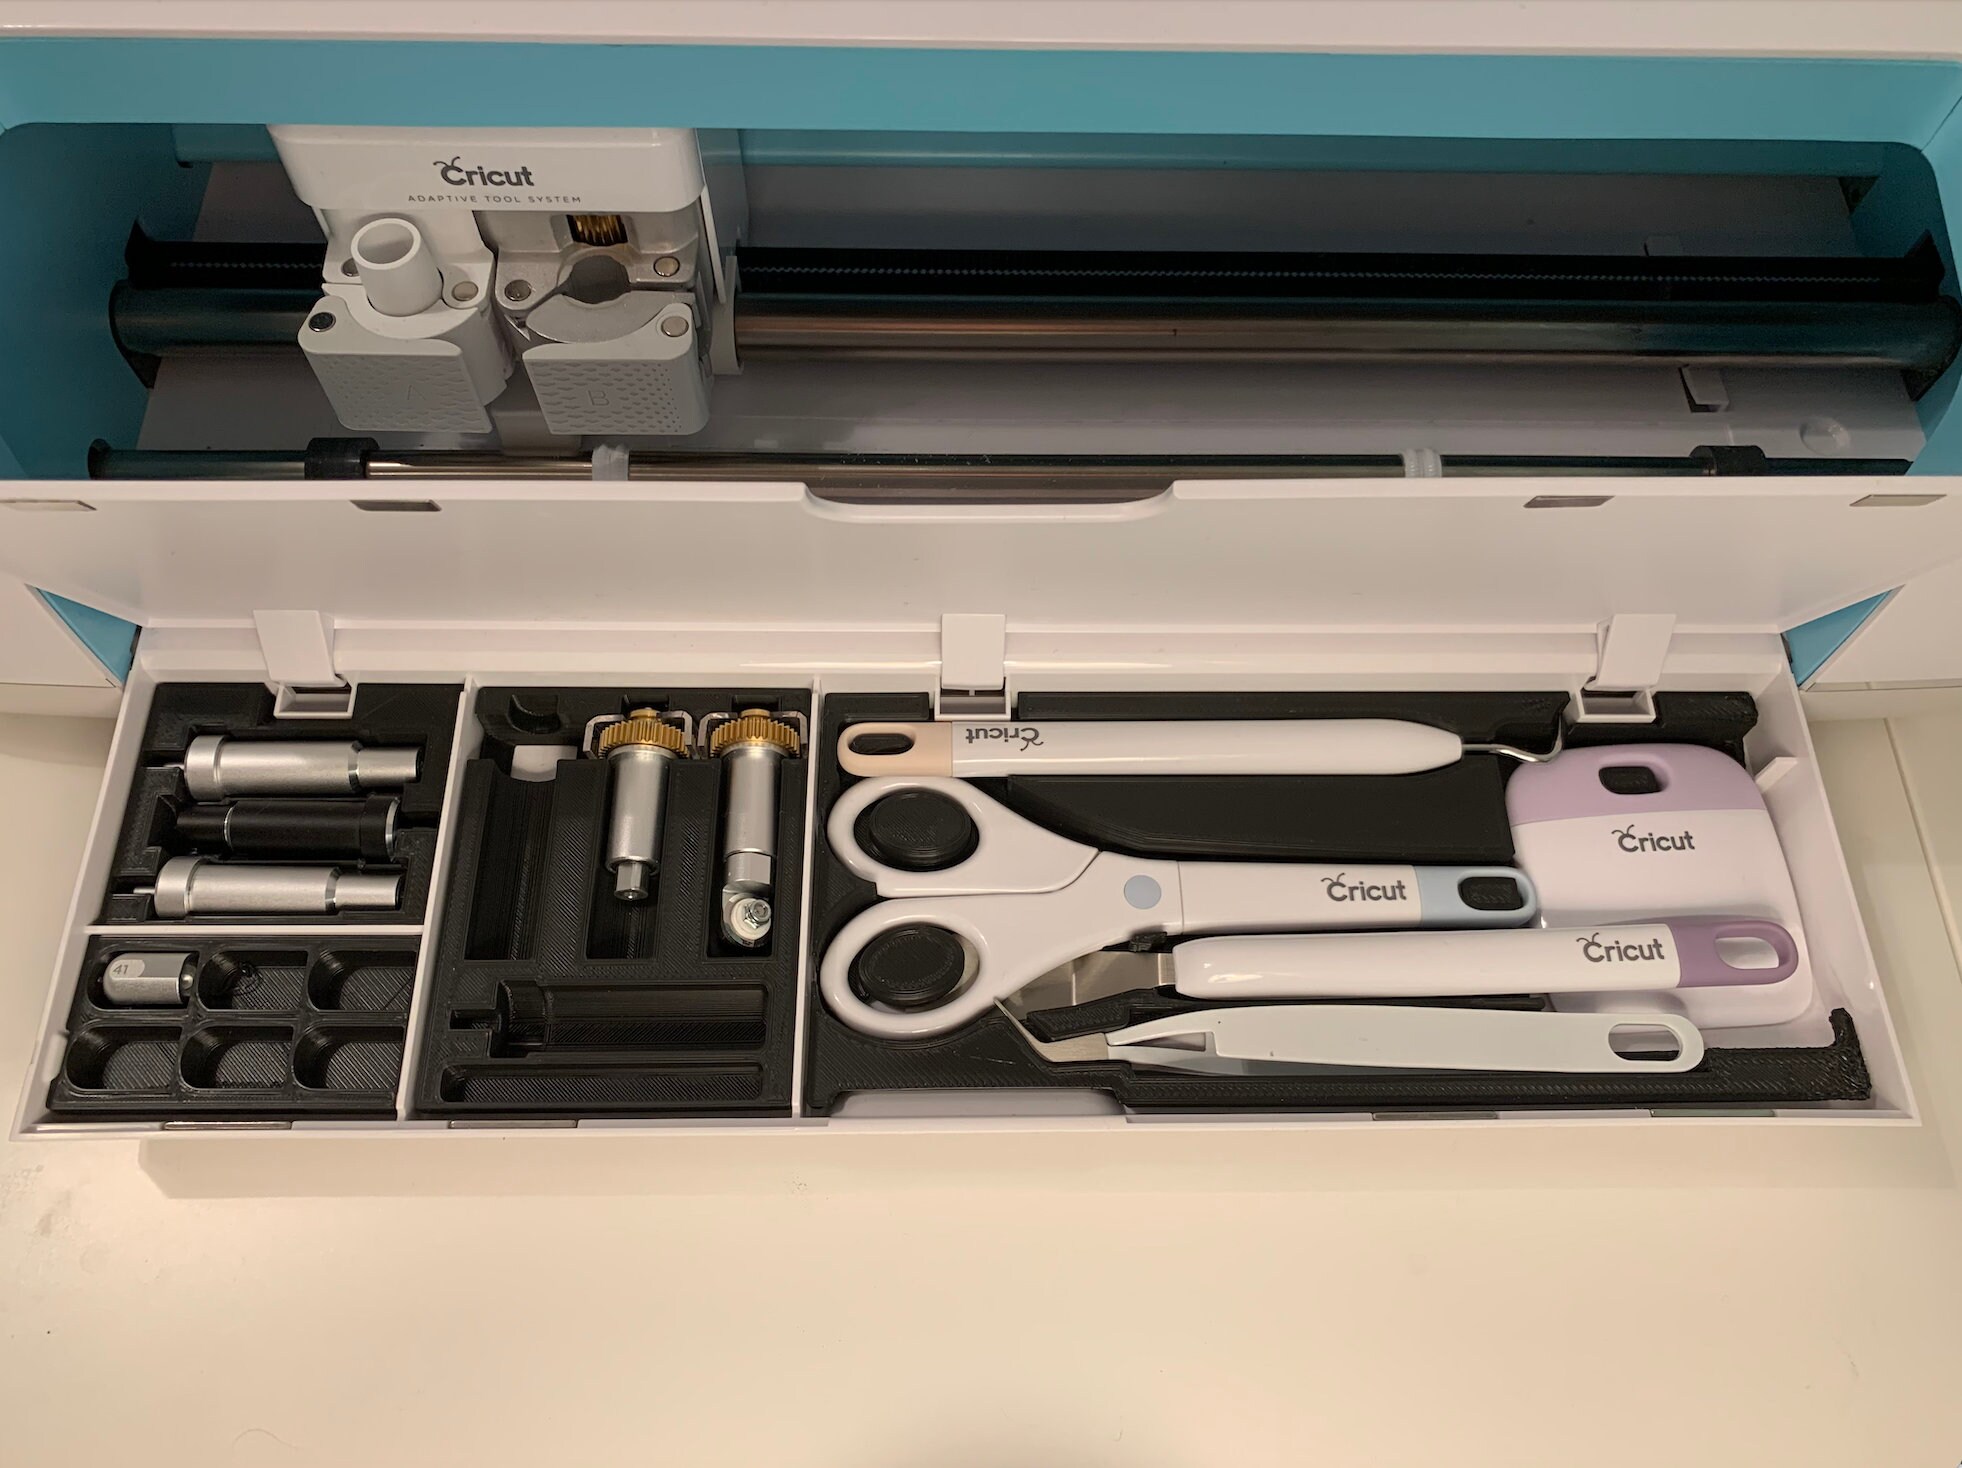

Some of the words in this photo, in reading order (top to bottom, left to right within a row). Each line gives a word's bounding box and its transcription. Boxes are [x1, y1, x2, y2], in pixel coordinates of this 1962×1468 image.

[433, 156, 535, 187] Cricut
[408, 194, 477, 203] ADAPTIVE
[484, 195, 521, 204] TOOL
[527, 195, 582, 204] SYSTEM
[588, 389, 611, 406] B
[965, 727, 1044, 752] Cricut
[1611, 823, 1695, 853] Cricut
[1320, 872, 1407, 902] Cricut
[1576, 932, 1665, 963] Cricut
[112, 964, 129, 975] 41
